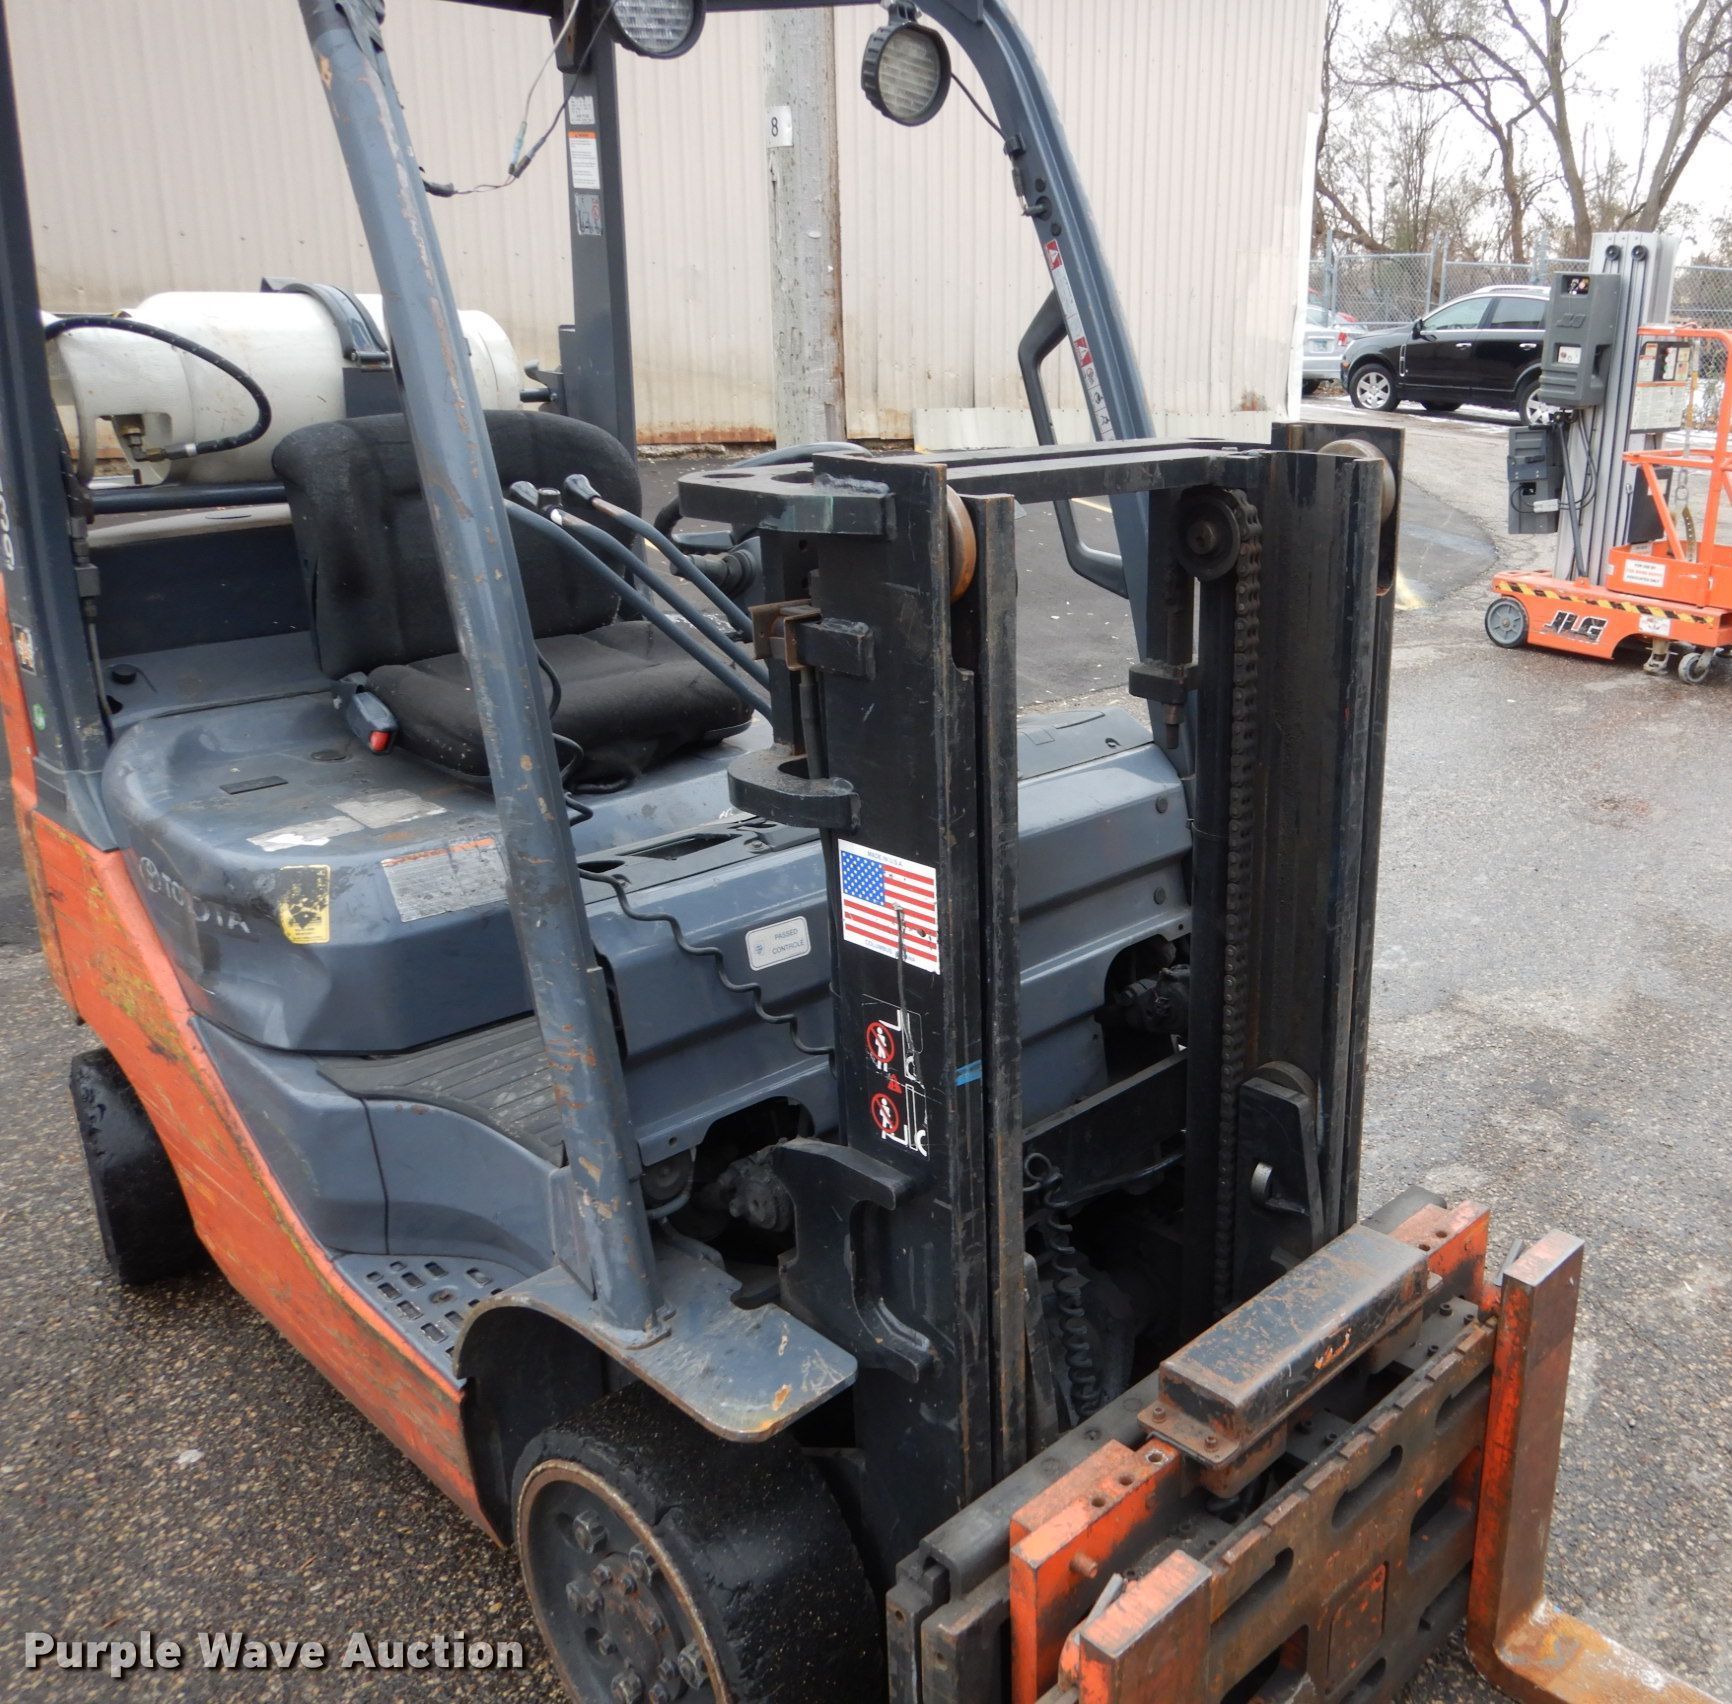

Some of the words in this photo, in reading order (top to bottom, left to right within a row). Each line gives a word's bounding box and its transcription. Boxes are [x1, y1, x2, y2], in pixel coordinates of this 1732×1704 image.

[771, 116, 779, 137] 8
[1544, 610, 1608, 643] JLG
[774, 928, 798, 940] PASSED
